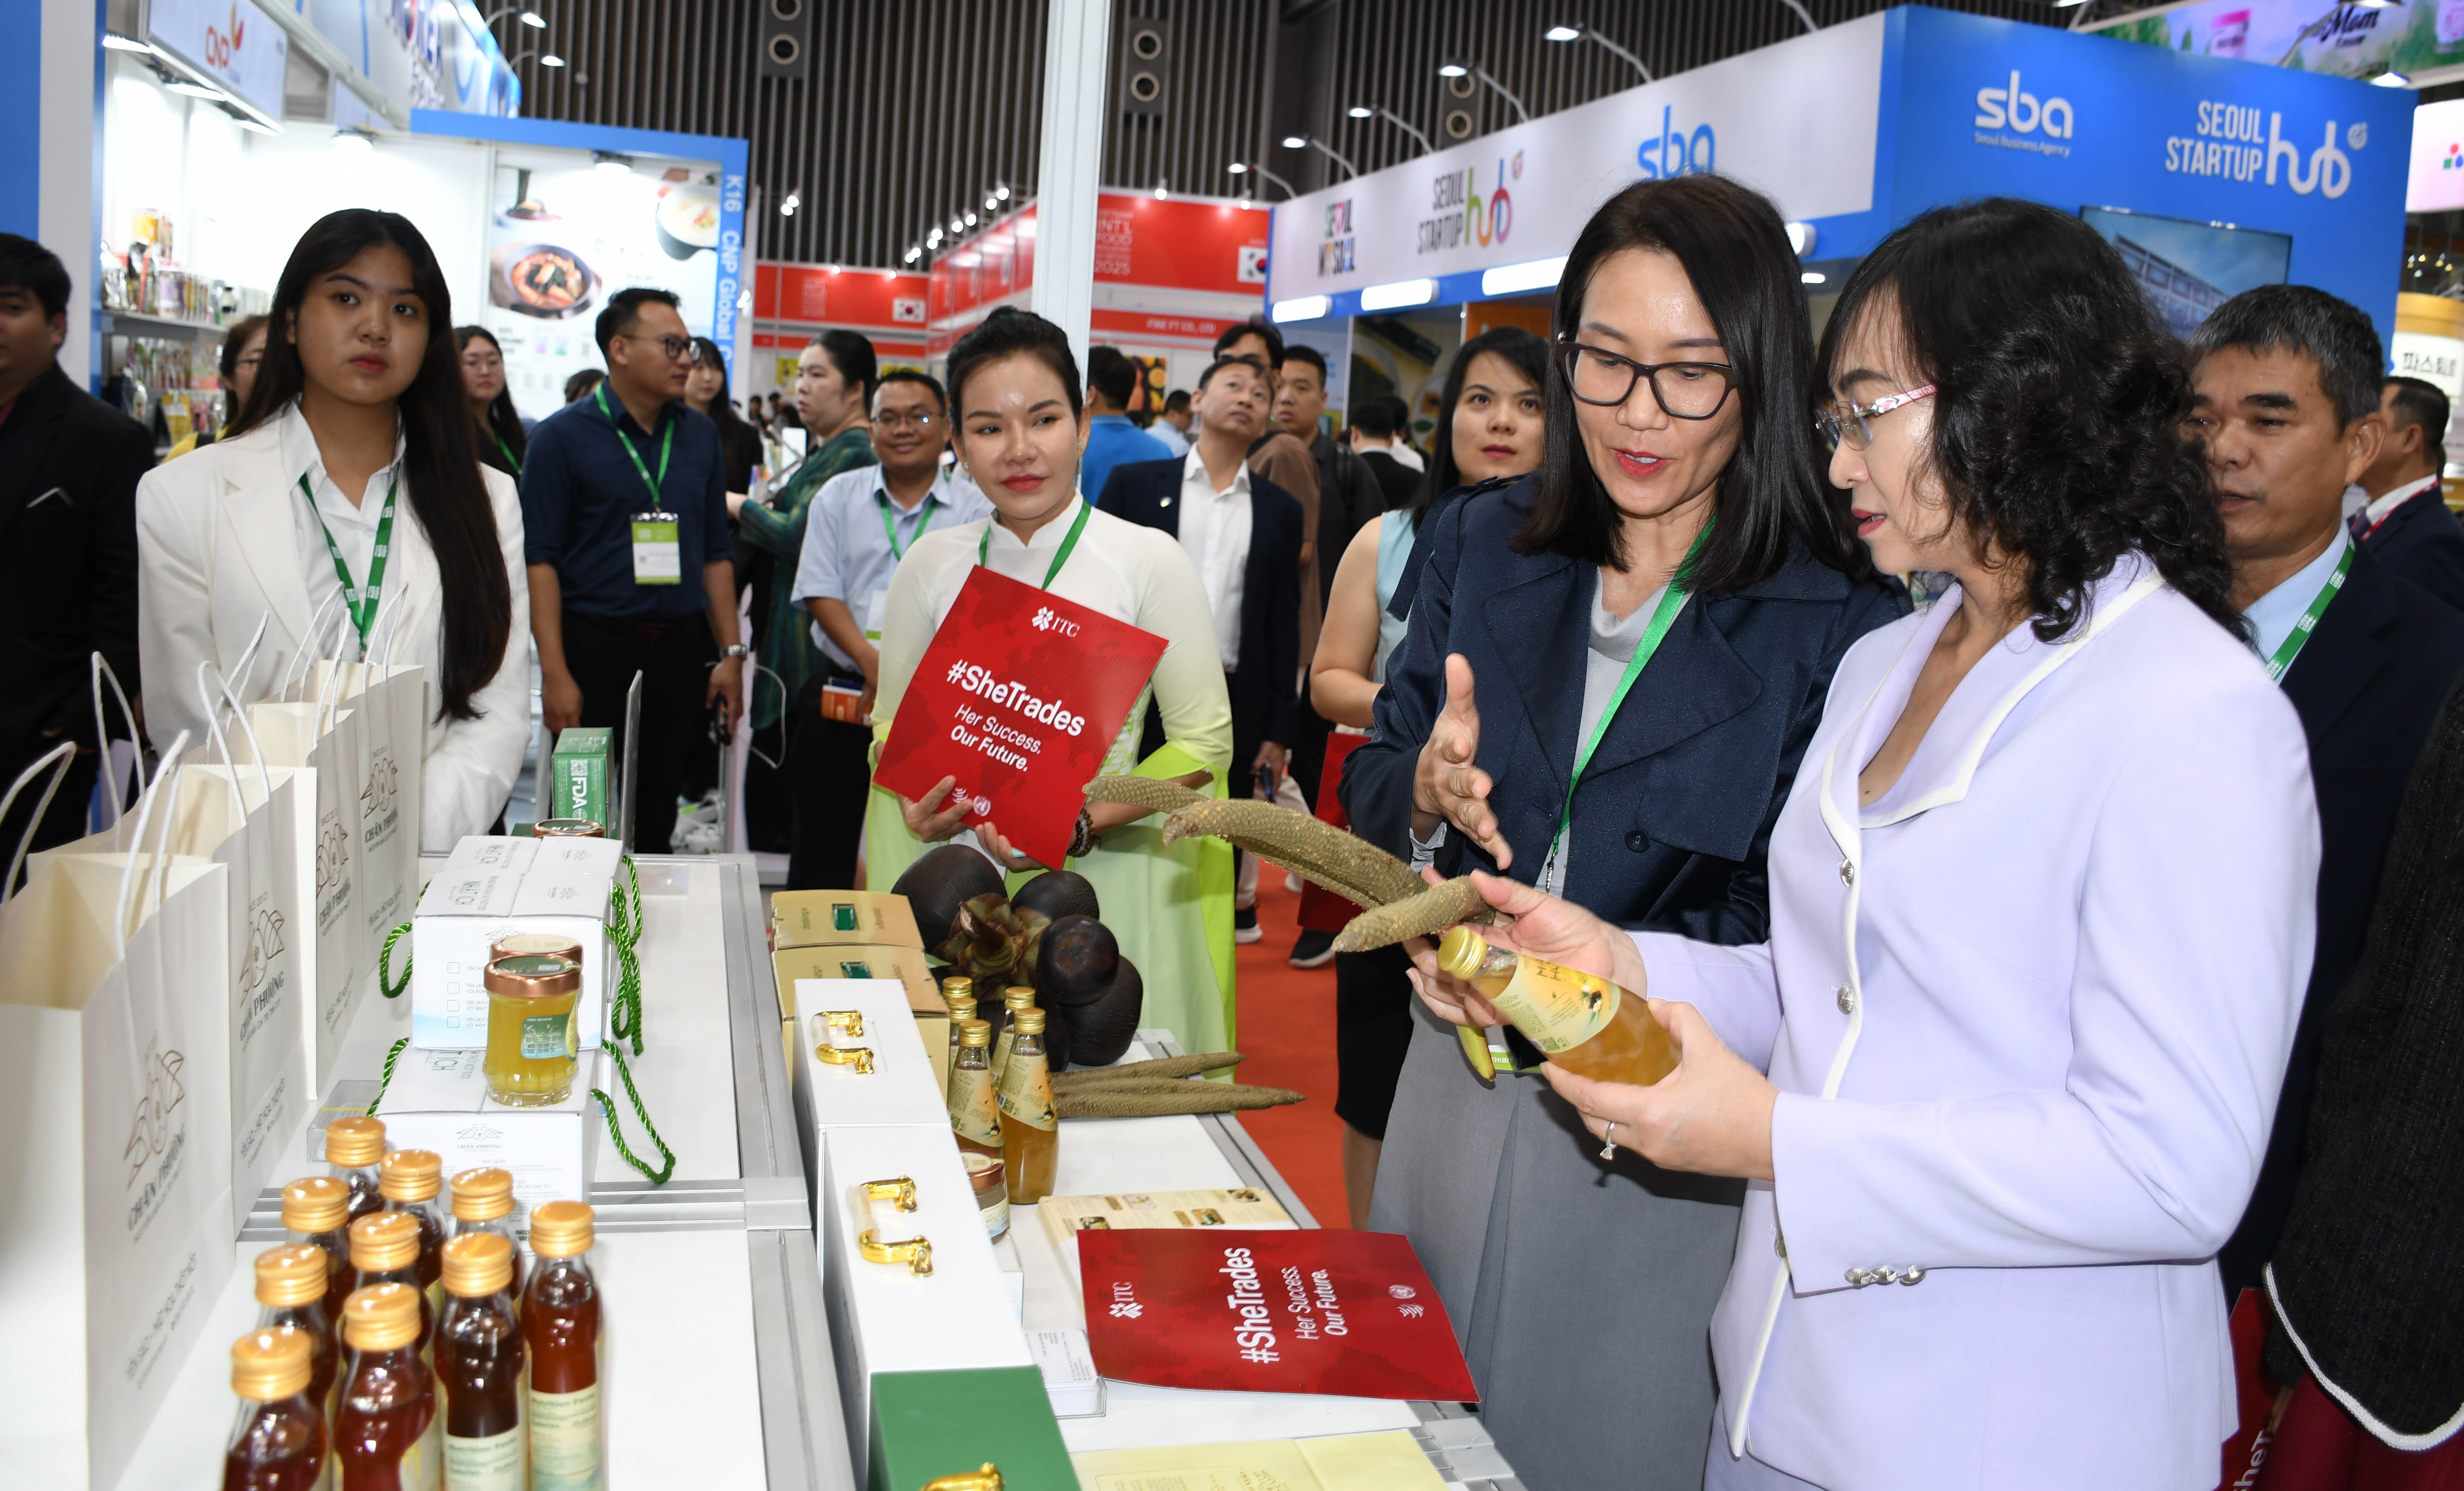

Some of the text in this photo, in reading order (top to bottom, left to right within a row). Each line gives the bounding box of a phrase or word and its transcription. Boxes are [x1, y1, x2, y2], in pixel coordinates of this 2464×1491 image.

[1975, 70, 2074, 139] sba
[2196, 100, 2265, 145] SEOUL
[1636, 105, 1715, 183] sba
[2164, 136, 2263, 183] STARTUP
[2265, 112, 2351, 199] hub
[725, 175, 743, 213] K16
[1433, 171, 1464, 210] SEOUL
[1464, 158, 1512, 248] hub
[721, 230, 740, 274] CNP
[1417, 211, 1463, 254] STARTUP
[716, 279, 737, 341] Global
[1051, 617, 1080, 637] ITC
[947, 660, 1085, 738] #SheTrades
[950, 725, 1029, 772] Our Future.
[954, 703, 1043, 754] Her Success.
[572, 776, 587, 809] FDA
[1113, 1282, 1134, 1303] ITC
[1219, 1248, 1282, 1364] #SheTrades
[1281, 1265, 1320, 1340] Her Success.
[1311, 1269, 1349, 1336] Our Future.
